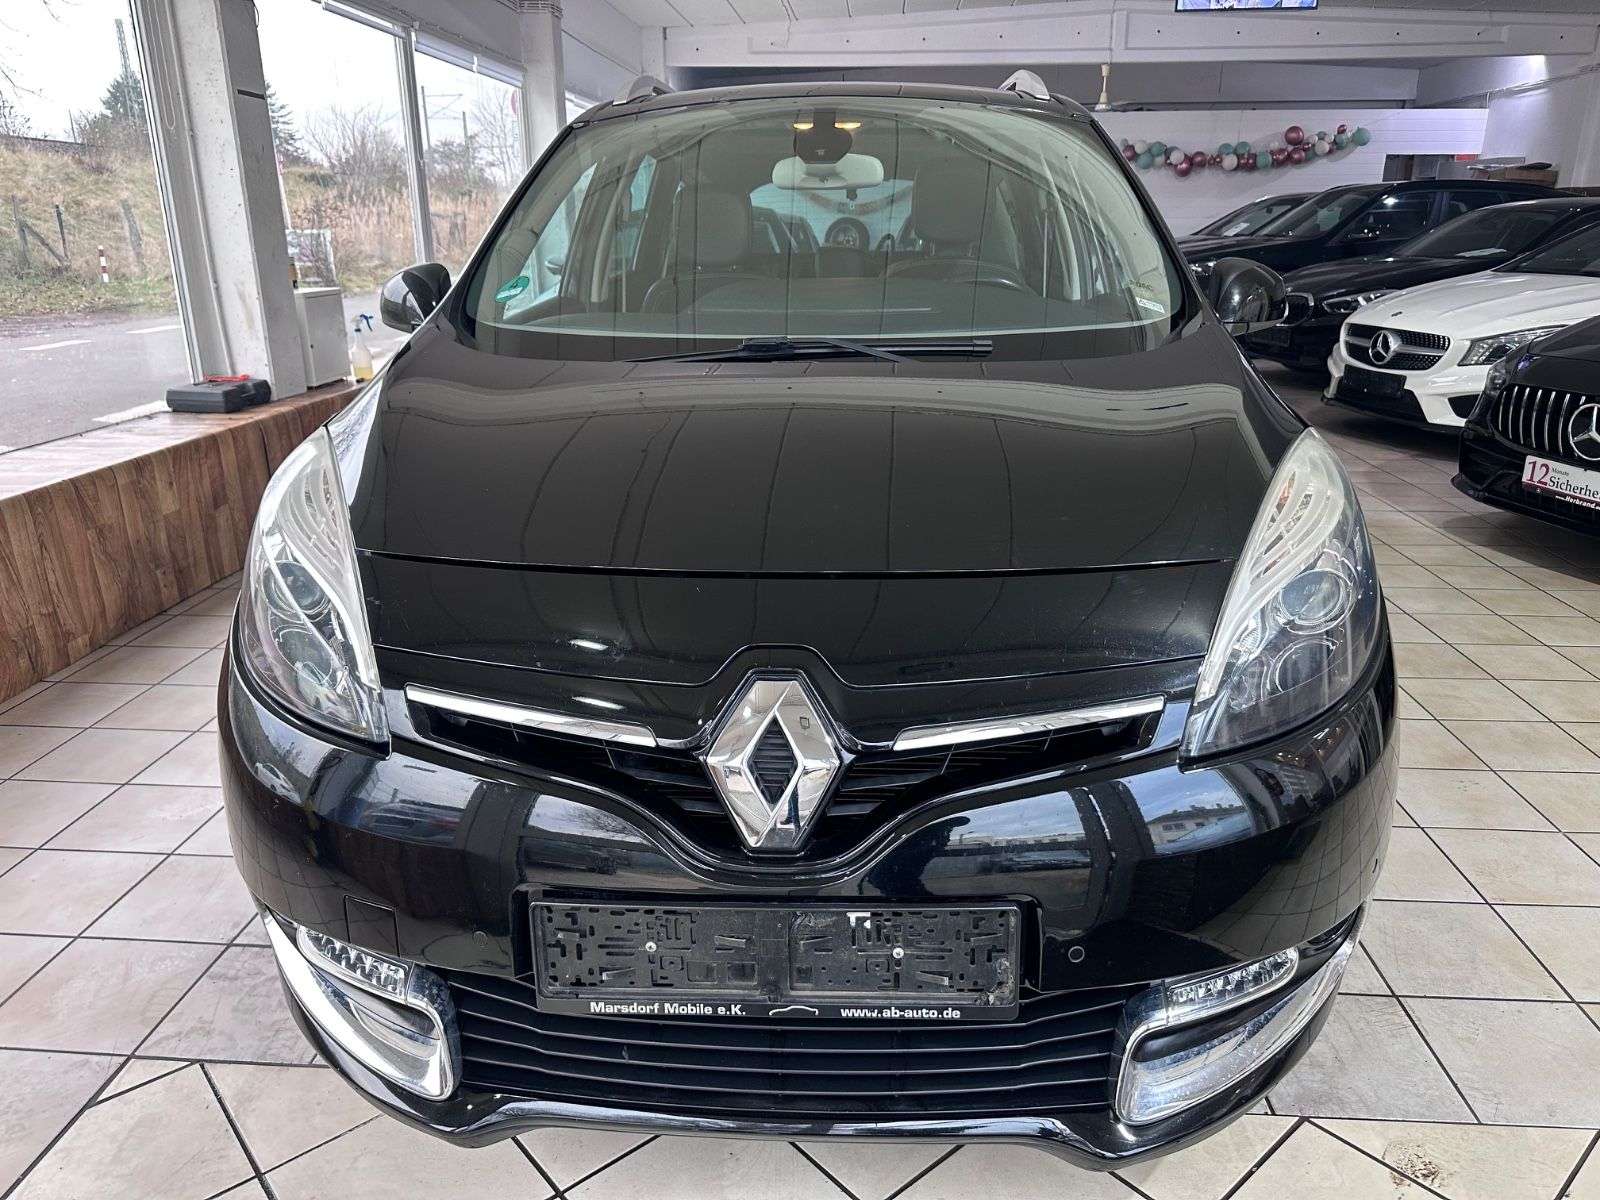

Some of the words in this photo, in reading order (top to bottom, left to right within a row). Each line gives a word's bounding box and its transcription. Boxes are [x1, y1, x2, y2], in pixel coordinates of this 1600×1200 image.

[1526, 460, 1550, 486] 12
[1549, 475, 1600, 499] Sicherhe
[590, 1001, 660, 1014] Marsdorf
[664, 1002, 713, 1015] Mobile
[717, 1004, 746, 1016] e.K.
[840, 1006, 961, 1019] www.ab-auto.de
